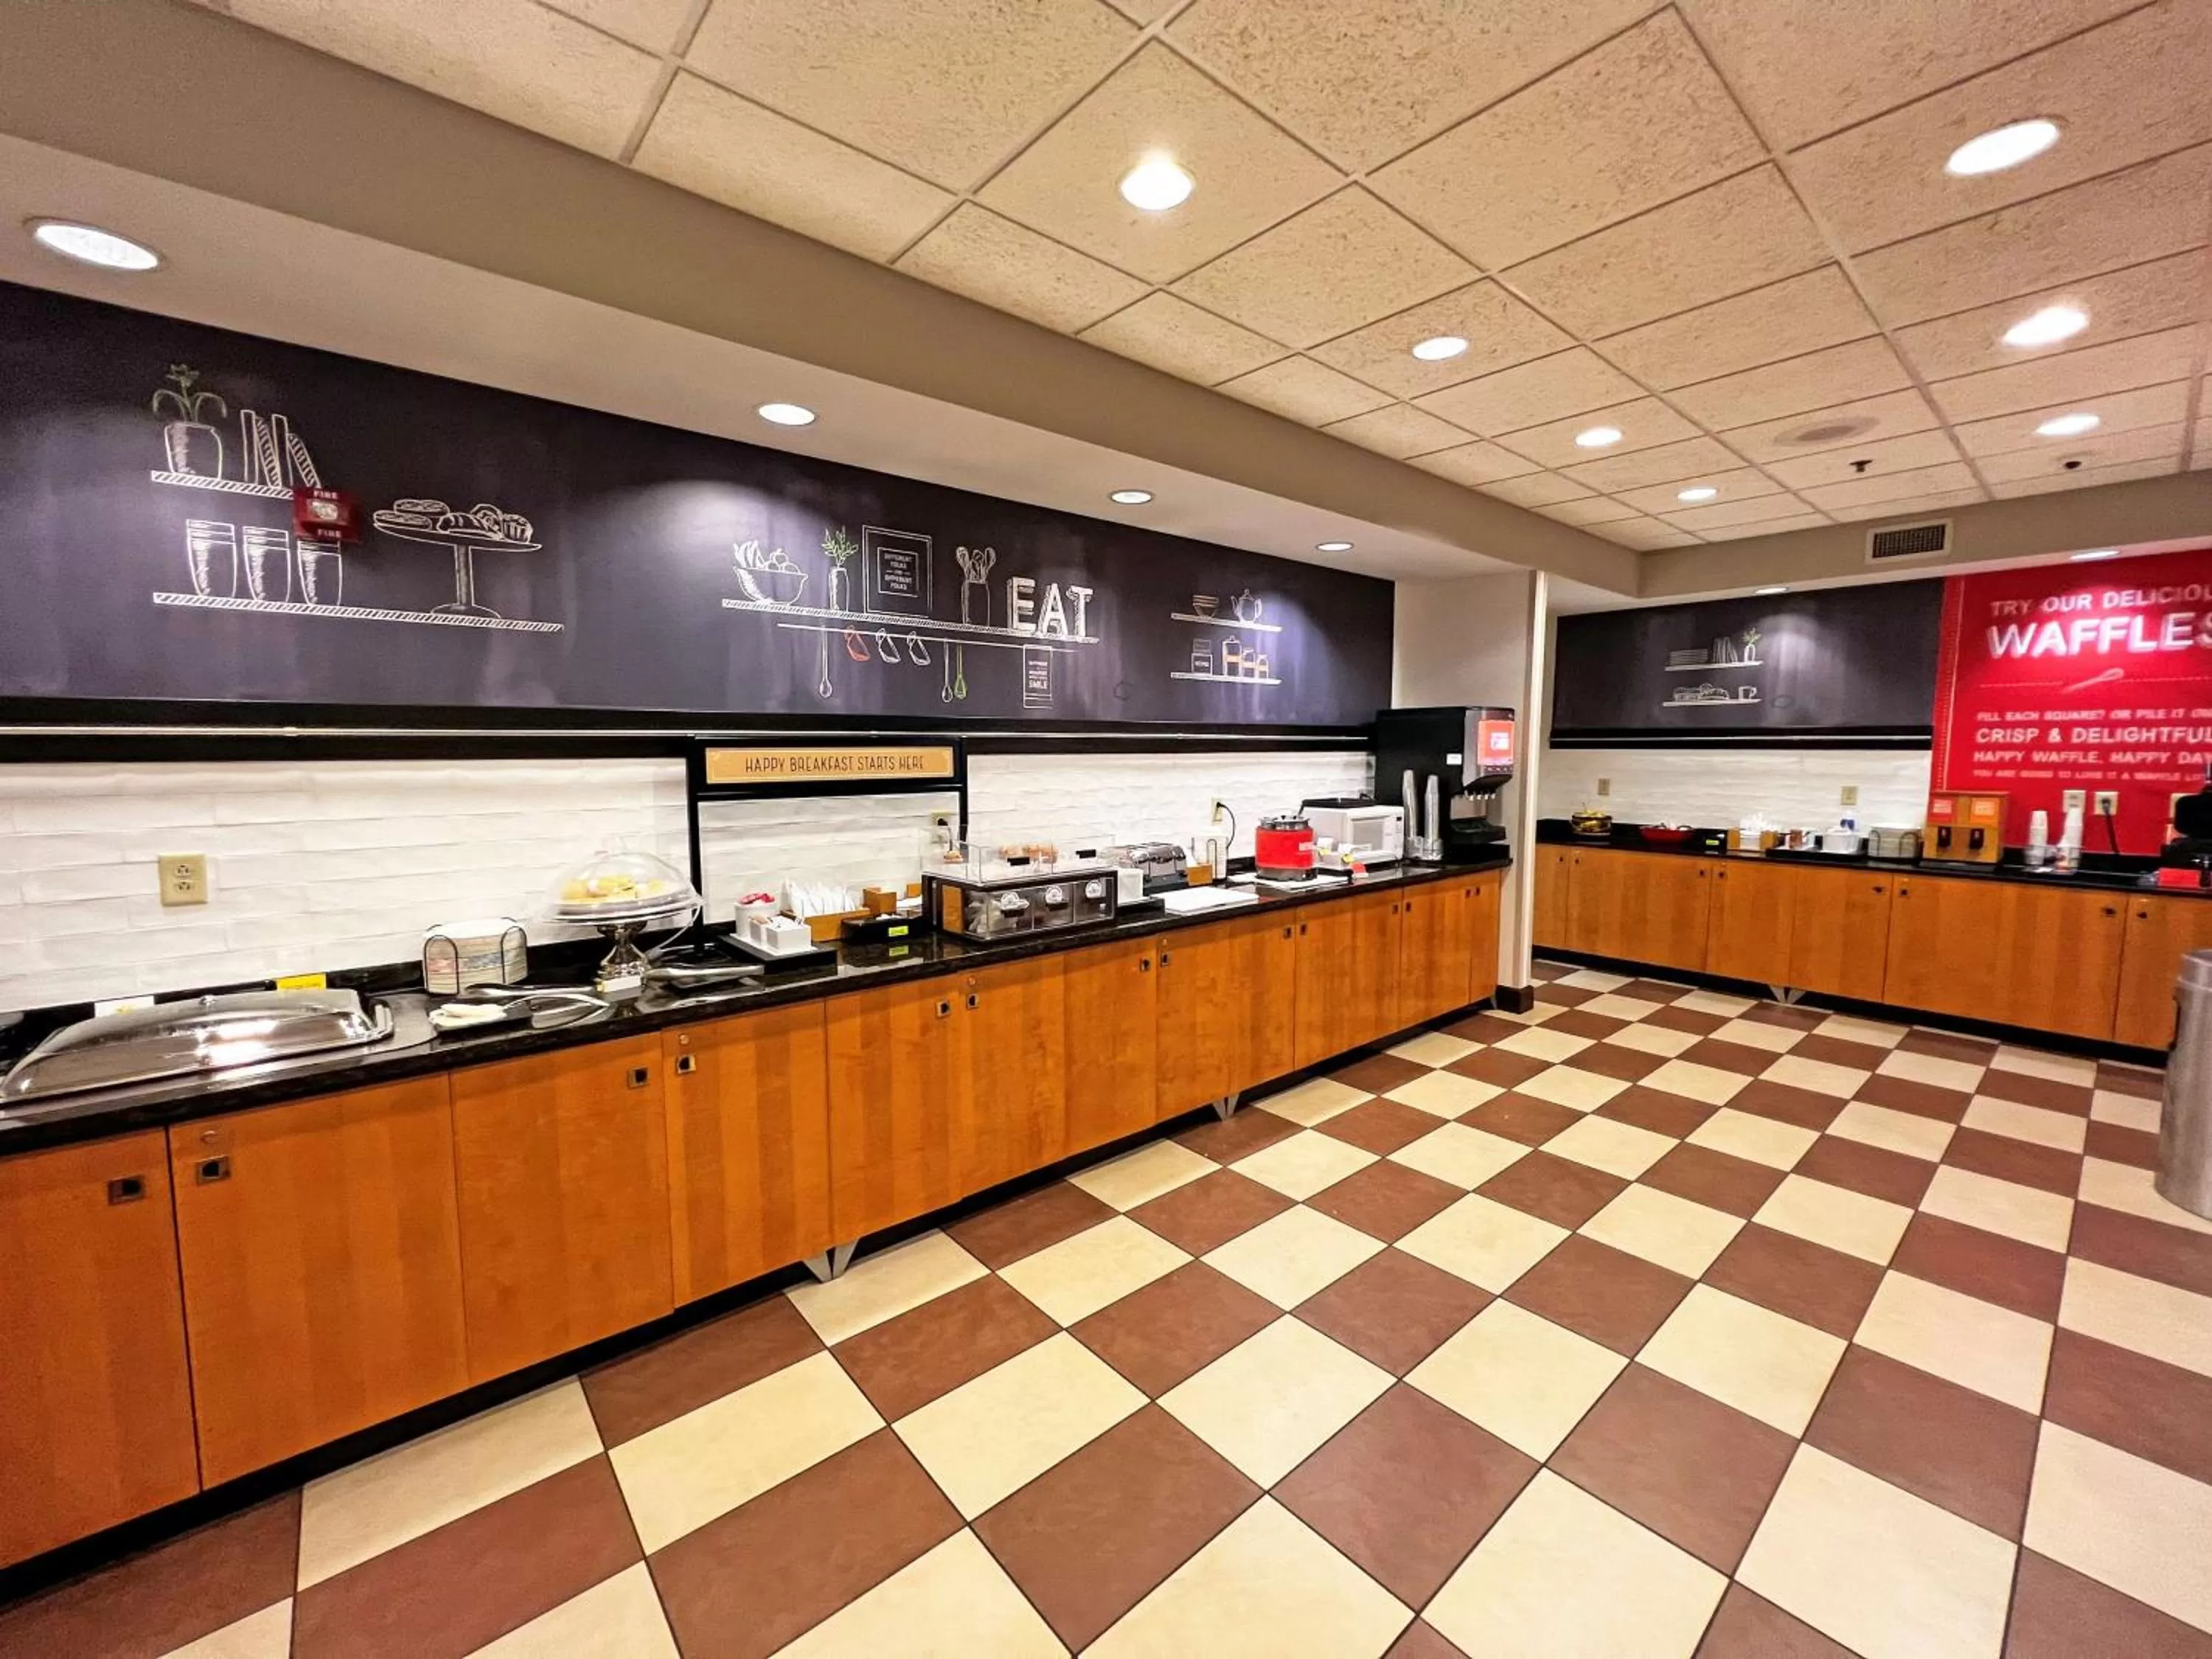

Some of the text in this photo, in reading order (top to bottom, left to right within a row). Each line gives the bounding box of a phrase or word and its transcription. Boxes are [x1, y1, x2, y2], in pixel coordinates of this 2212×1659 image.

[313, 490, 337, 499] FIRE
[318, 529, 341, 538] FIRE
[1006, 577, 1093, 638] EAT
[1991, 599, 2032, 616] TRY
[2041, 594, 2093, 613] OUR
[2005, 711, 2040, 720] EACH
[1975, 726, 2212, 744] CRISP & DELIGHTFUL
[745, 755, 924, 773] HAPPY BREAKFAST STARTS HERE
[1973, 751, 2025, 762] HAPPY
[2110, 751, 2171, 764] HAPPY
